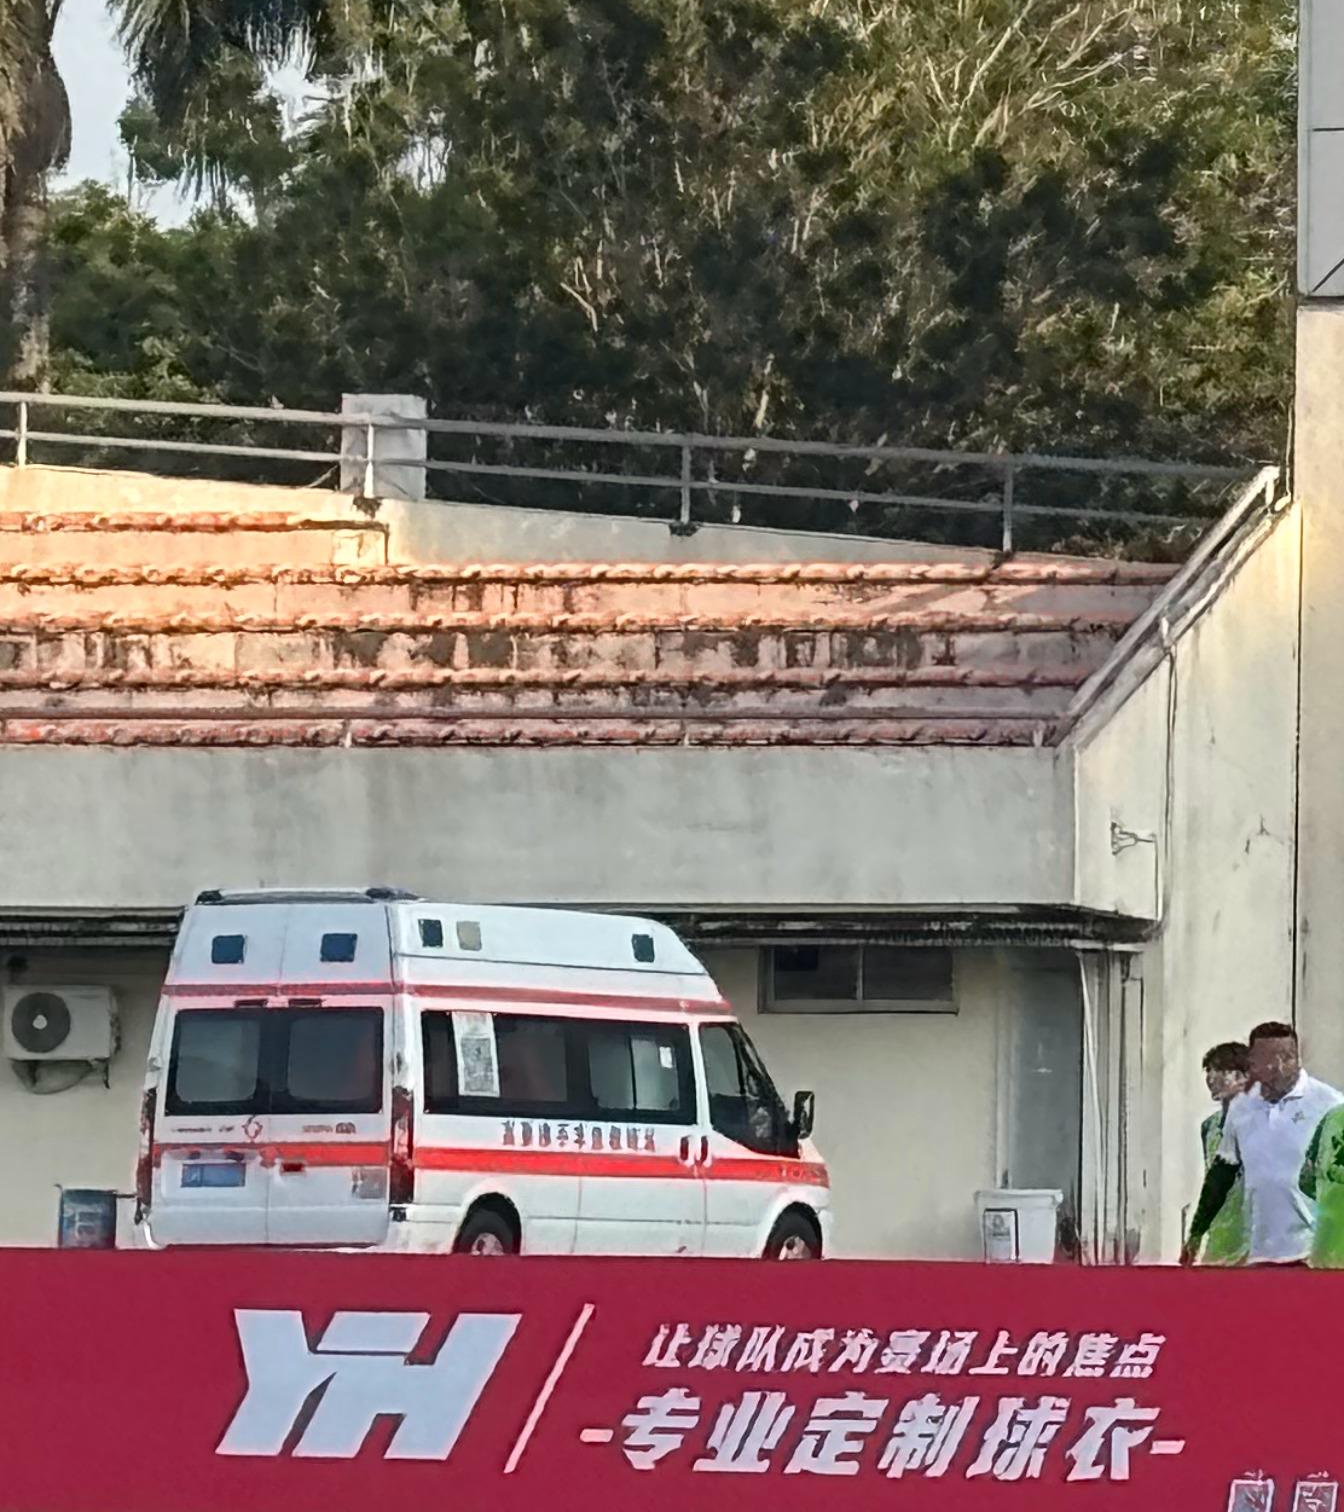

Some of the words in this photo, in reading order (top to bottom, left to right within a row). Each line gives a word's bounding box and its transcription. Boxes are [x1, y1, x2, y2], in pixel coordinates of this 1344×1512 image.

[642, 1323, 1166, 1379] 让球队成为赛场上的焦点
